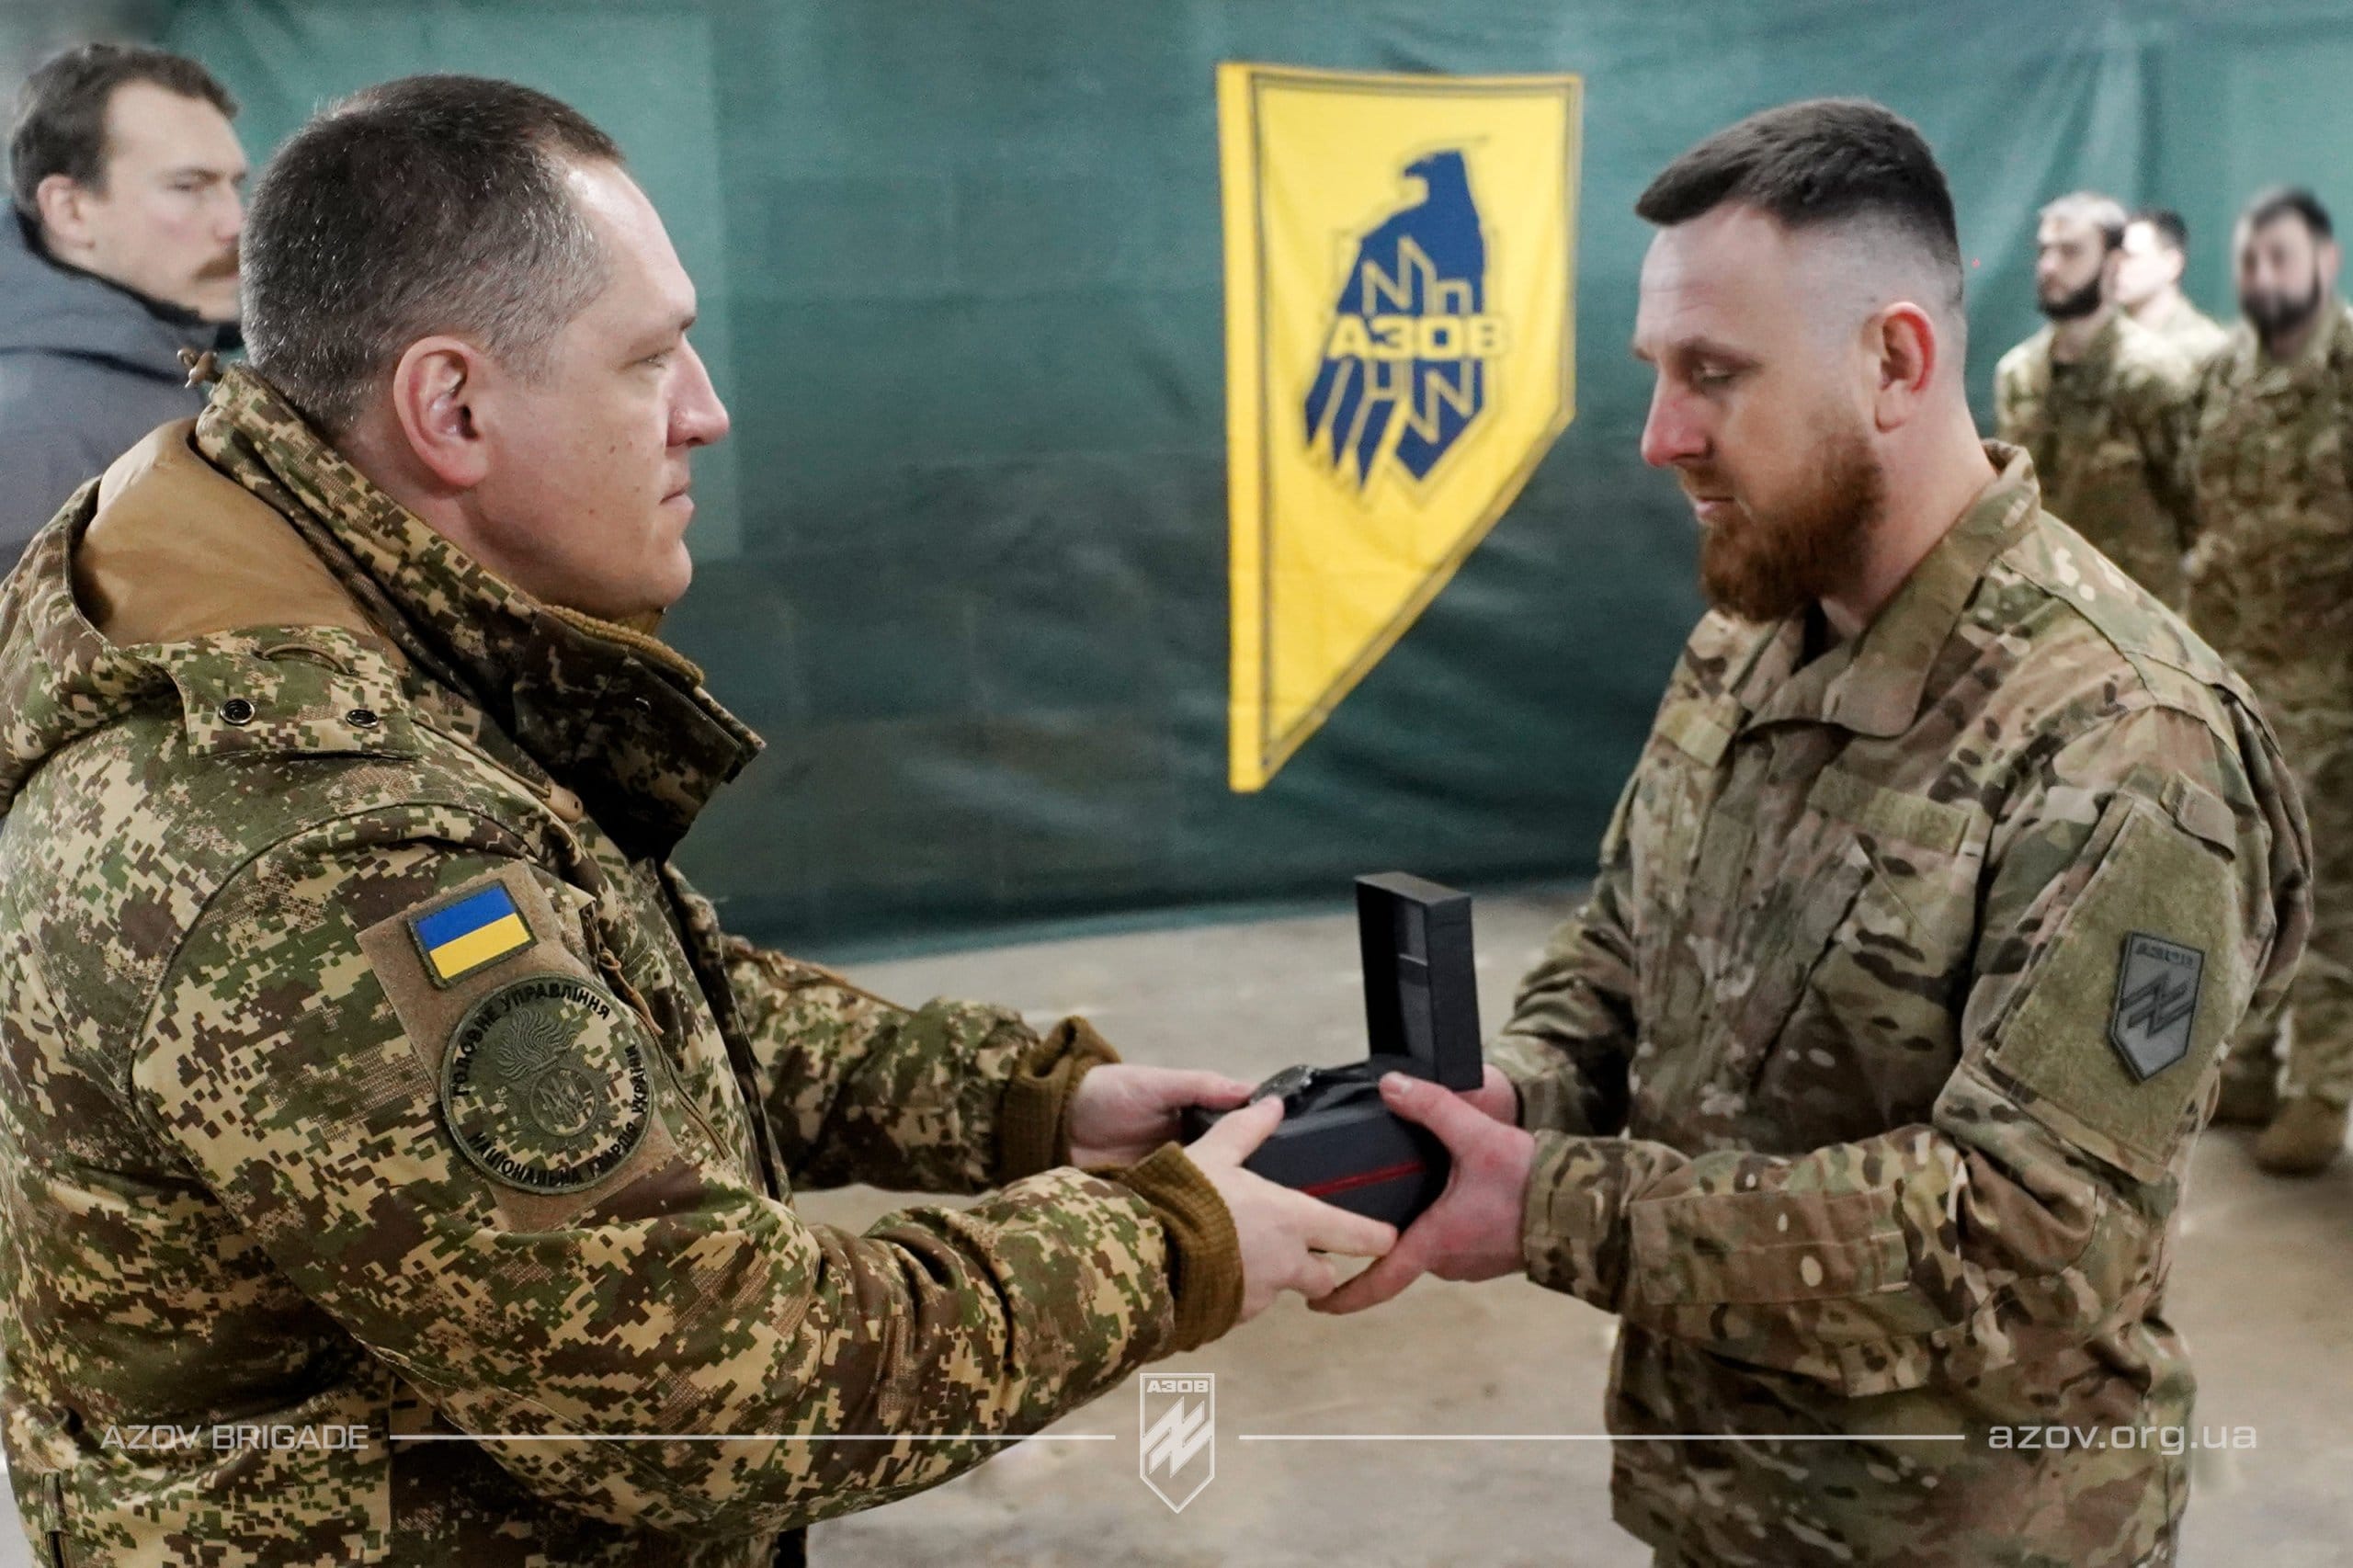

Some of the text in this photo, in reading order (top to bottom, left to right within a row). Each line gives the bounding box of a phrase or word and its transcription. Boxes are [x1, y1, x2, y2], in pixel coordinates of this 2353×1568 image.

[1327, 315, 1506, 359] АЗОВ
[452, 983, 610, 1096] ГОЛОВНЕ УПРАВЛІННЯ
[467, 1131, 583, 1186] НАЦІОНАЛЬНА
